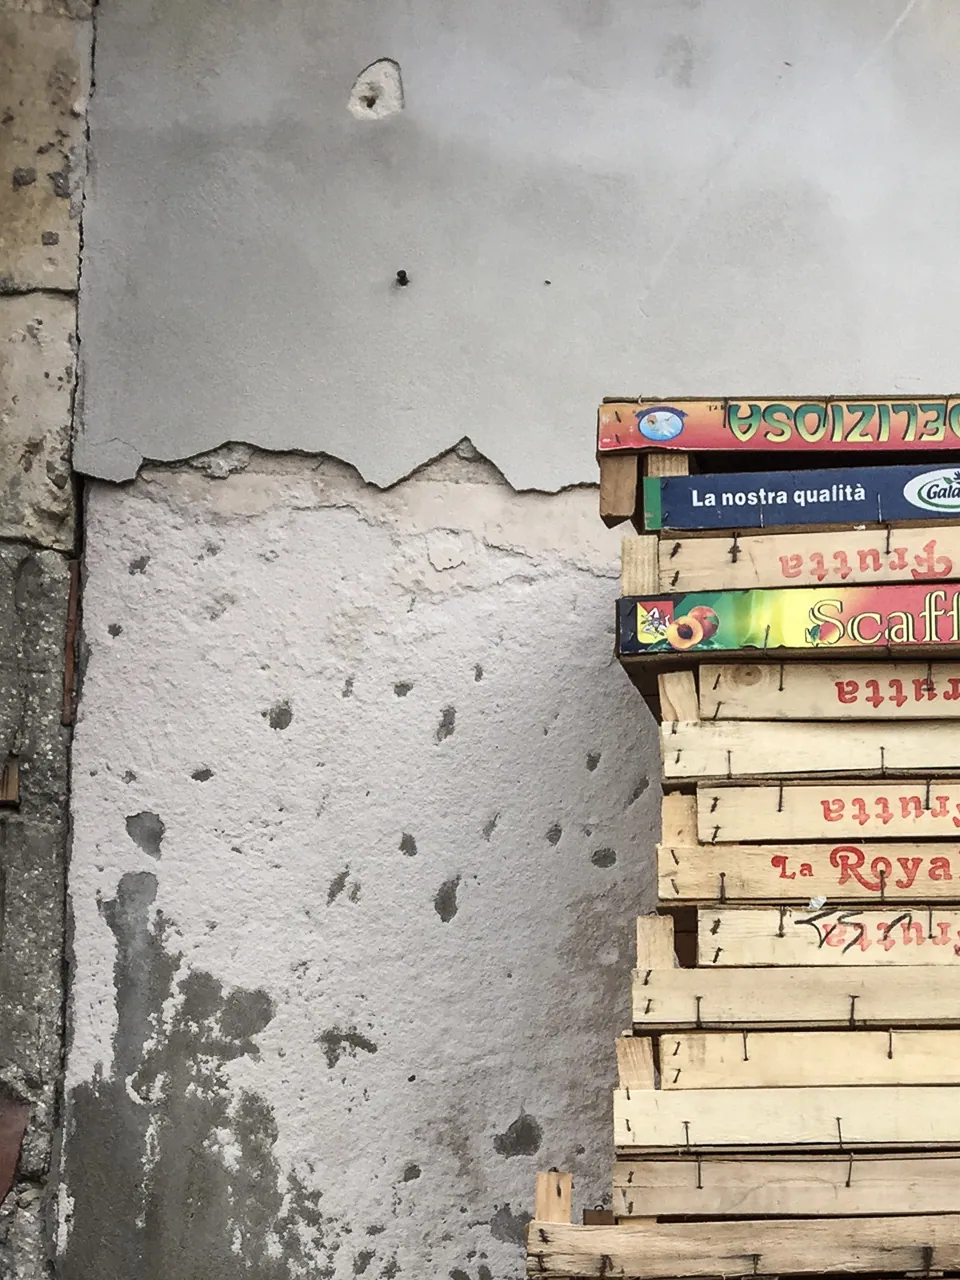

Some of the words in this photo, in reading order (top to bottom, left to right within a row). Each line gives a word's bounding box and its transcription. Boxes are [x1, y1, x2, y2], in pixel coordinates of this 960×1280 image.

[692, 489, 716, 507] La
[721, 488, 788, 506] nostra
[793, 483, 867, 507] qualità
[779, 538, 953, 581] Frutta
[771, 854, 815, 881] La
